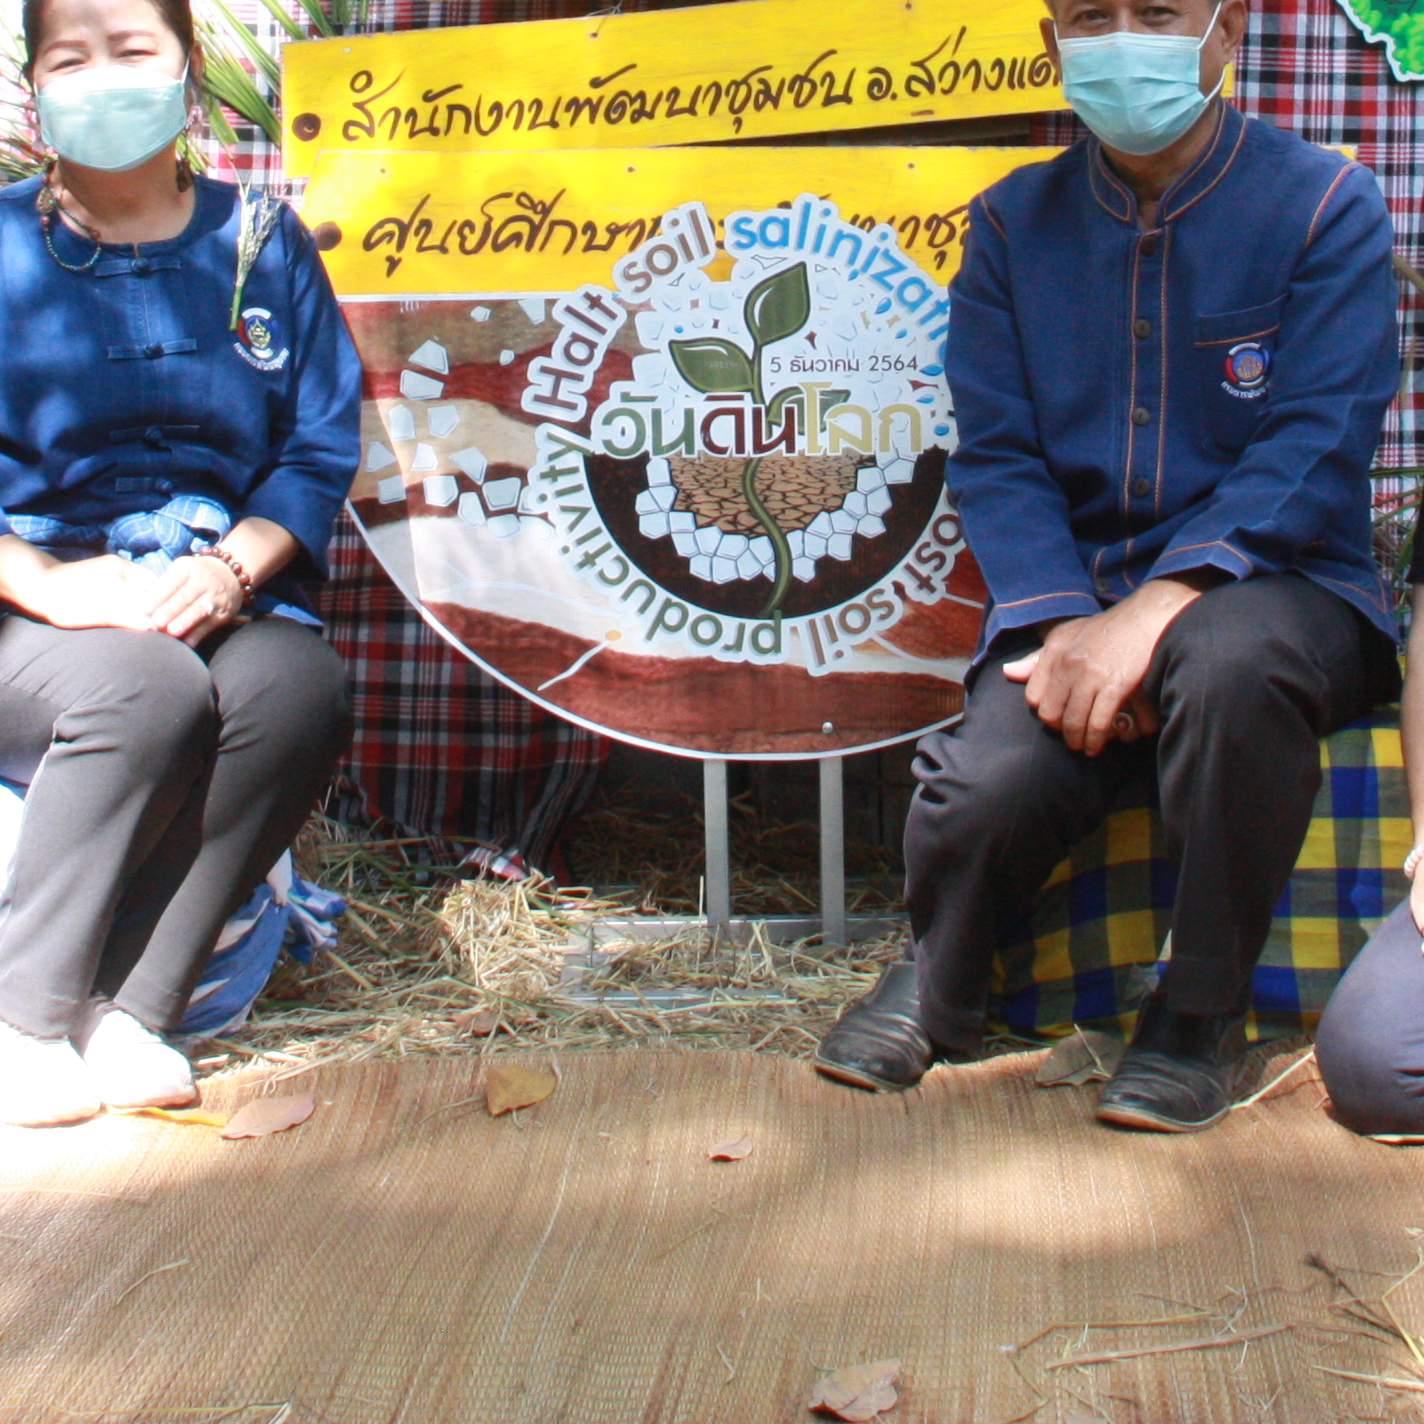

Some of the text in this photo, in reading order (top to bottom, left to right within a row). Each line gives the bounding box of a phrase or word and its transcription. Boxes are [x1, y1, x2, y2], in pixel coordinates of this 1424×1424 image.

[341, 26, 1063, 143] สำนักงานพัฒนาชุมชน อ.สว่างแด
[533, 290, 618, 412] Halt
[622, 209, 711, 293] soil
[769, 354, 919, 373] 5 ธันวาคม 2564
[601, 380, 924, 458] วันดินโลก
[539, 430, 783, 656] productivity
[808, 587, 896, 668] soil
